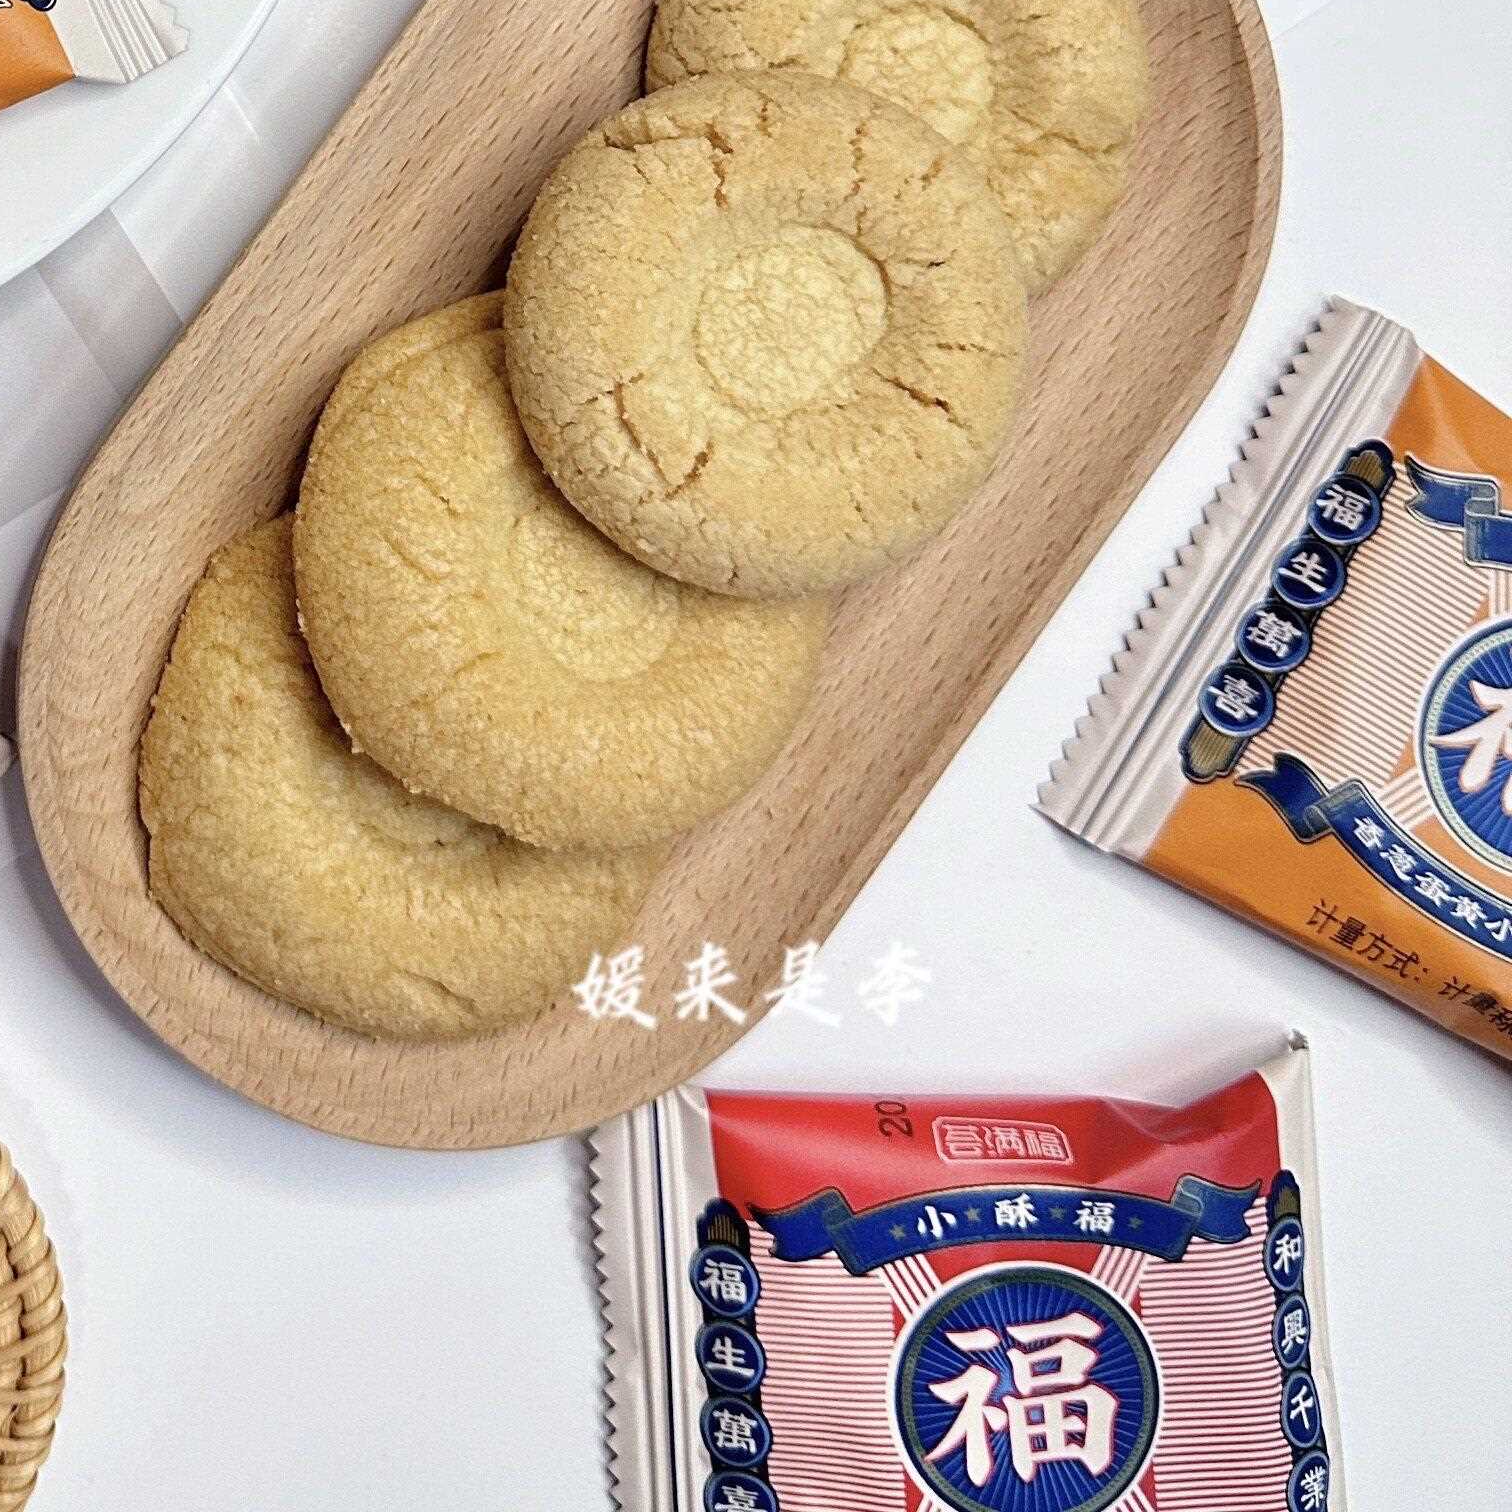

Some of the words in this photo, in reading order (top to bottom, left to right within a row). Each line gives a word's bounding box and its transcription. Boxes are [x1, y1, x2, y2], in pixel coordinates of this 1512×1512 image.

[1212, 487, 1365, 719] 福生萬喜
[1353, 816, 1512, 942] 香葱蛋黄小
[917, 1198, 1115, 1238] 小酥福
[927, 1312, 1118, 1481] 福
